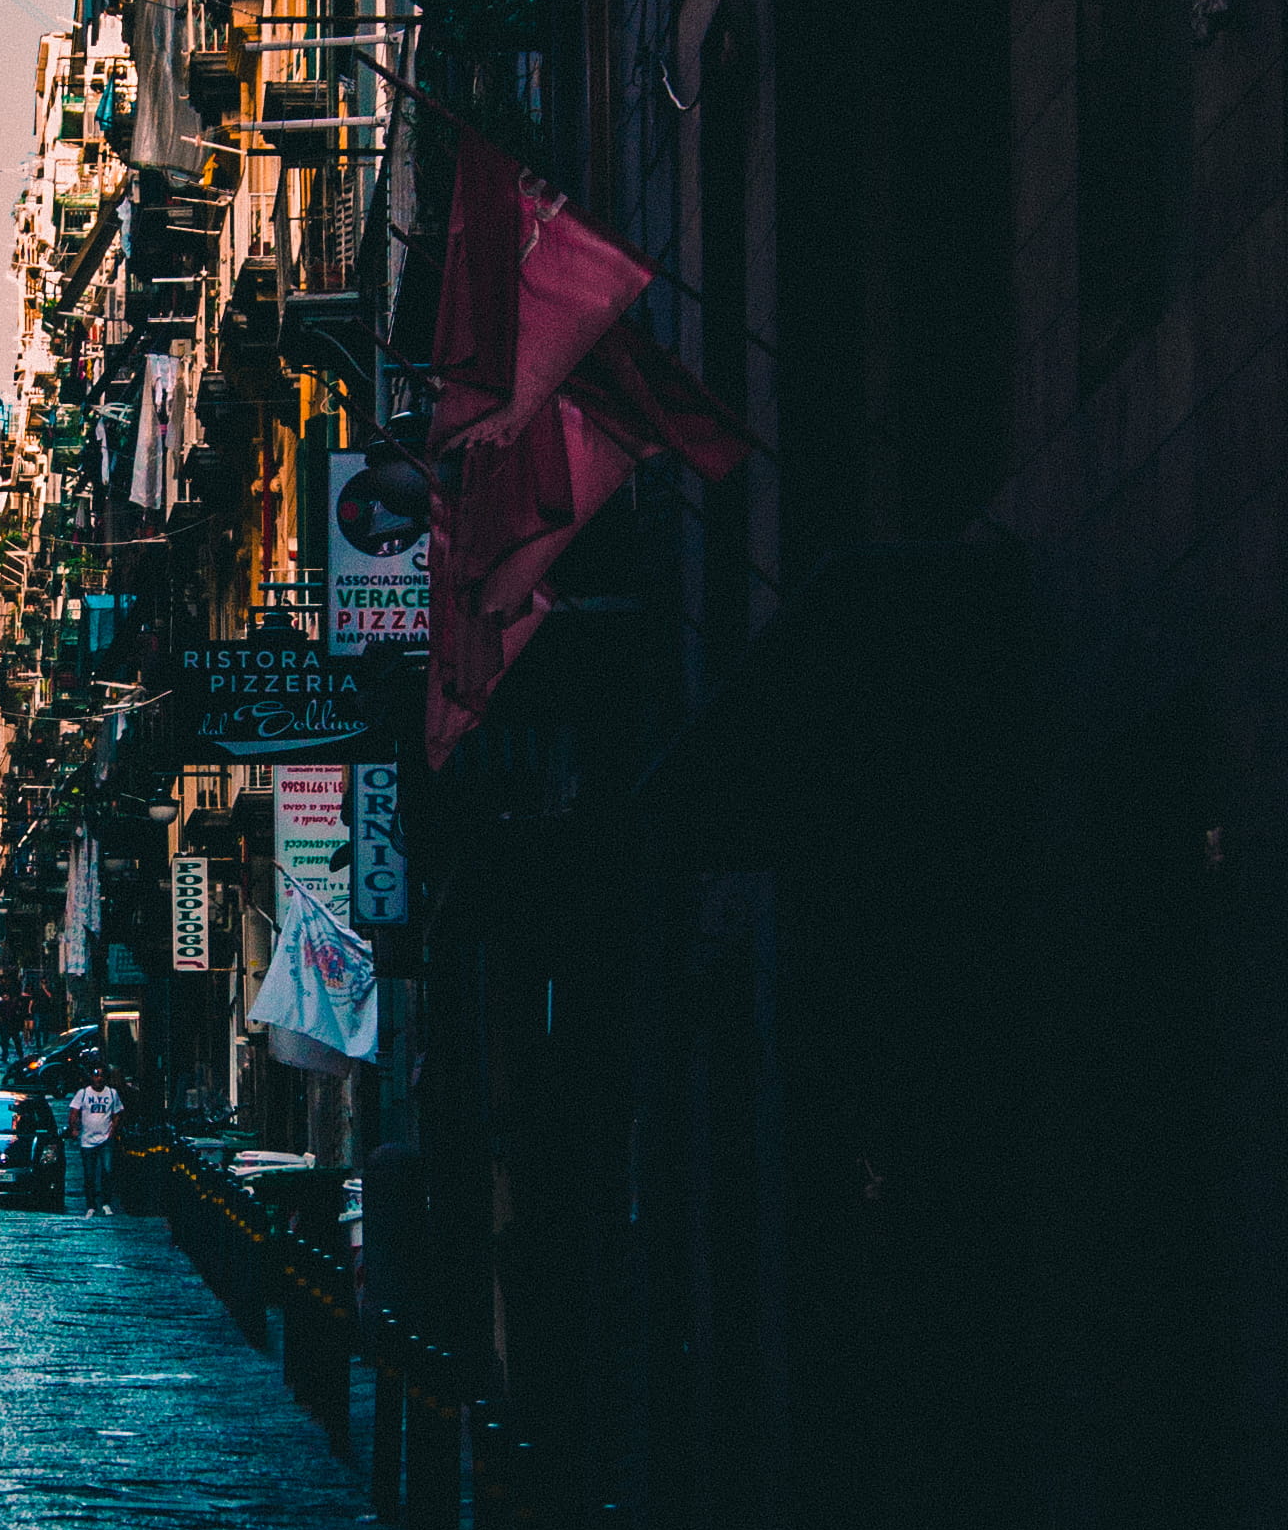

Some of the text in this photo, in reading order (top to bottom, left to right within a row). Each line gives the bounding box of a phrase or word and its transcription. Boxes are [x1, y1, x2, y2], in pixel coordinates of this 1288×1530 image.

[335, 574, 430, 587] ASSOCIAZIONE
[336, 588, 430, 608] VERACE
[337, 611, 430, 630] PIZZA
[336, 631, 430, 645] NAPOLETANA
[182, 650, 320, 669] RISTORA
[209, 674, 359, 694] PIZZERIA
[197, 712, 229, 736] dal
[362, 767, 399, 918] ORNICI
[292, 855, 331, 868] ranzi
[175, 862, 204, 958] PODOLOGO
